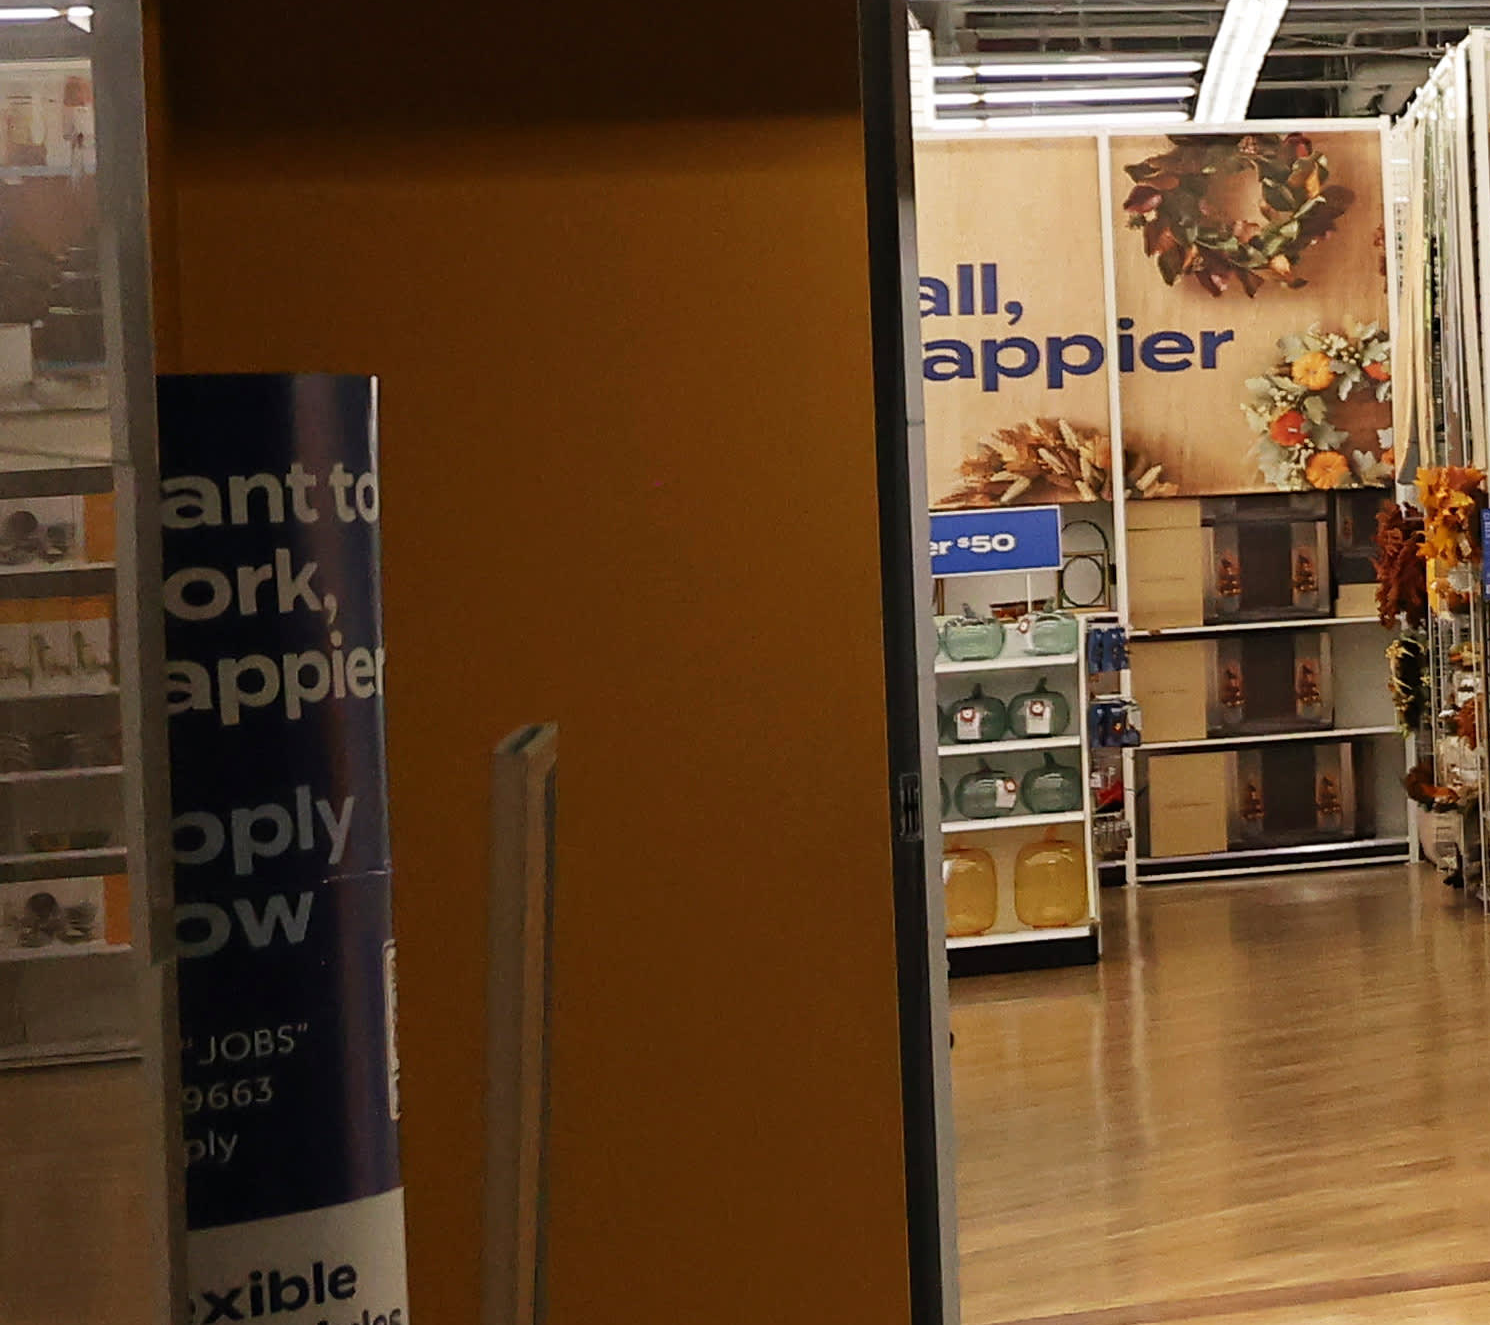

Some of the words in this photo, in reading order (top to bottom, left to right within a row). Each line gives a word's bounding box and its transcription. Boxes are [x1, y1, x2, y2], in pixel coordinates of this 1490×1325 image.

[919, 262, 1024, 326] all,
[922, 317, 1235, 393] appier
[161, 462, 320, 529] ant
[328, 461, 379, 524] to
[929, 539, 953, 556] er
[957, 532, 1017, 554] $50
[163, 547, 338, 624] ork,
[165, 630, 386, 725] appier
[175, 890, 315, 959] ow
[183, 1077, 274, 1116] 9663
[185, 1131, 239, 1166] ply
[189, 1260, 358, 1325] xible
